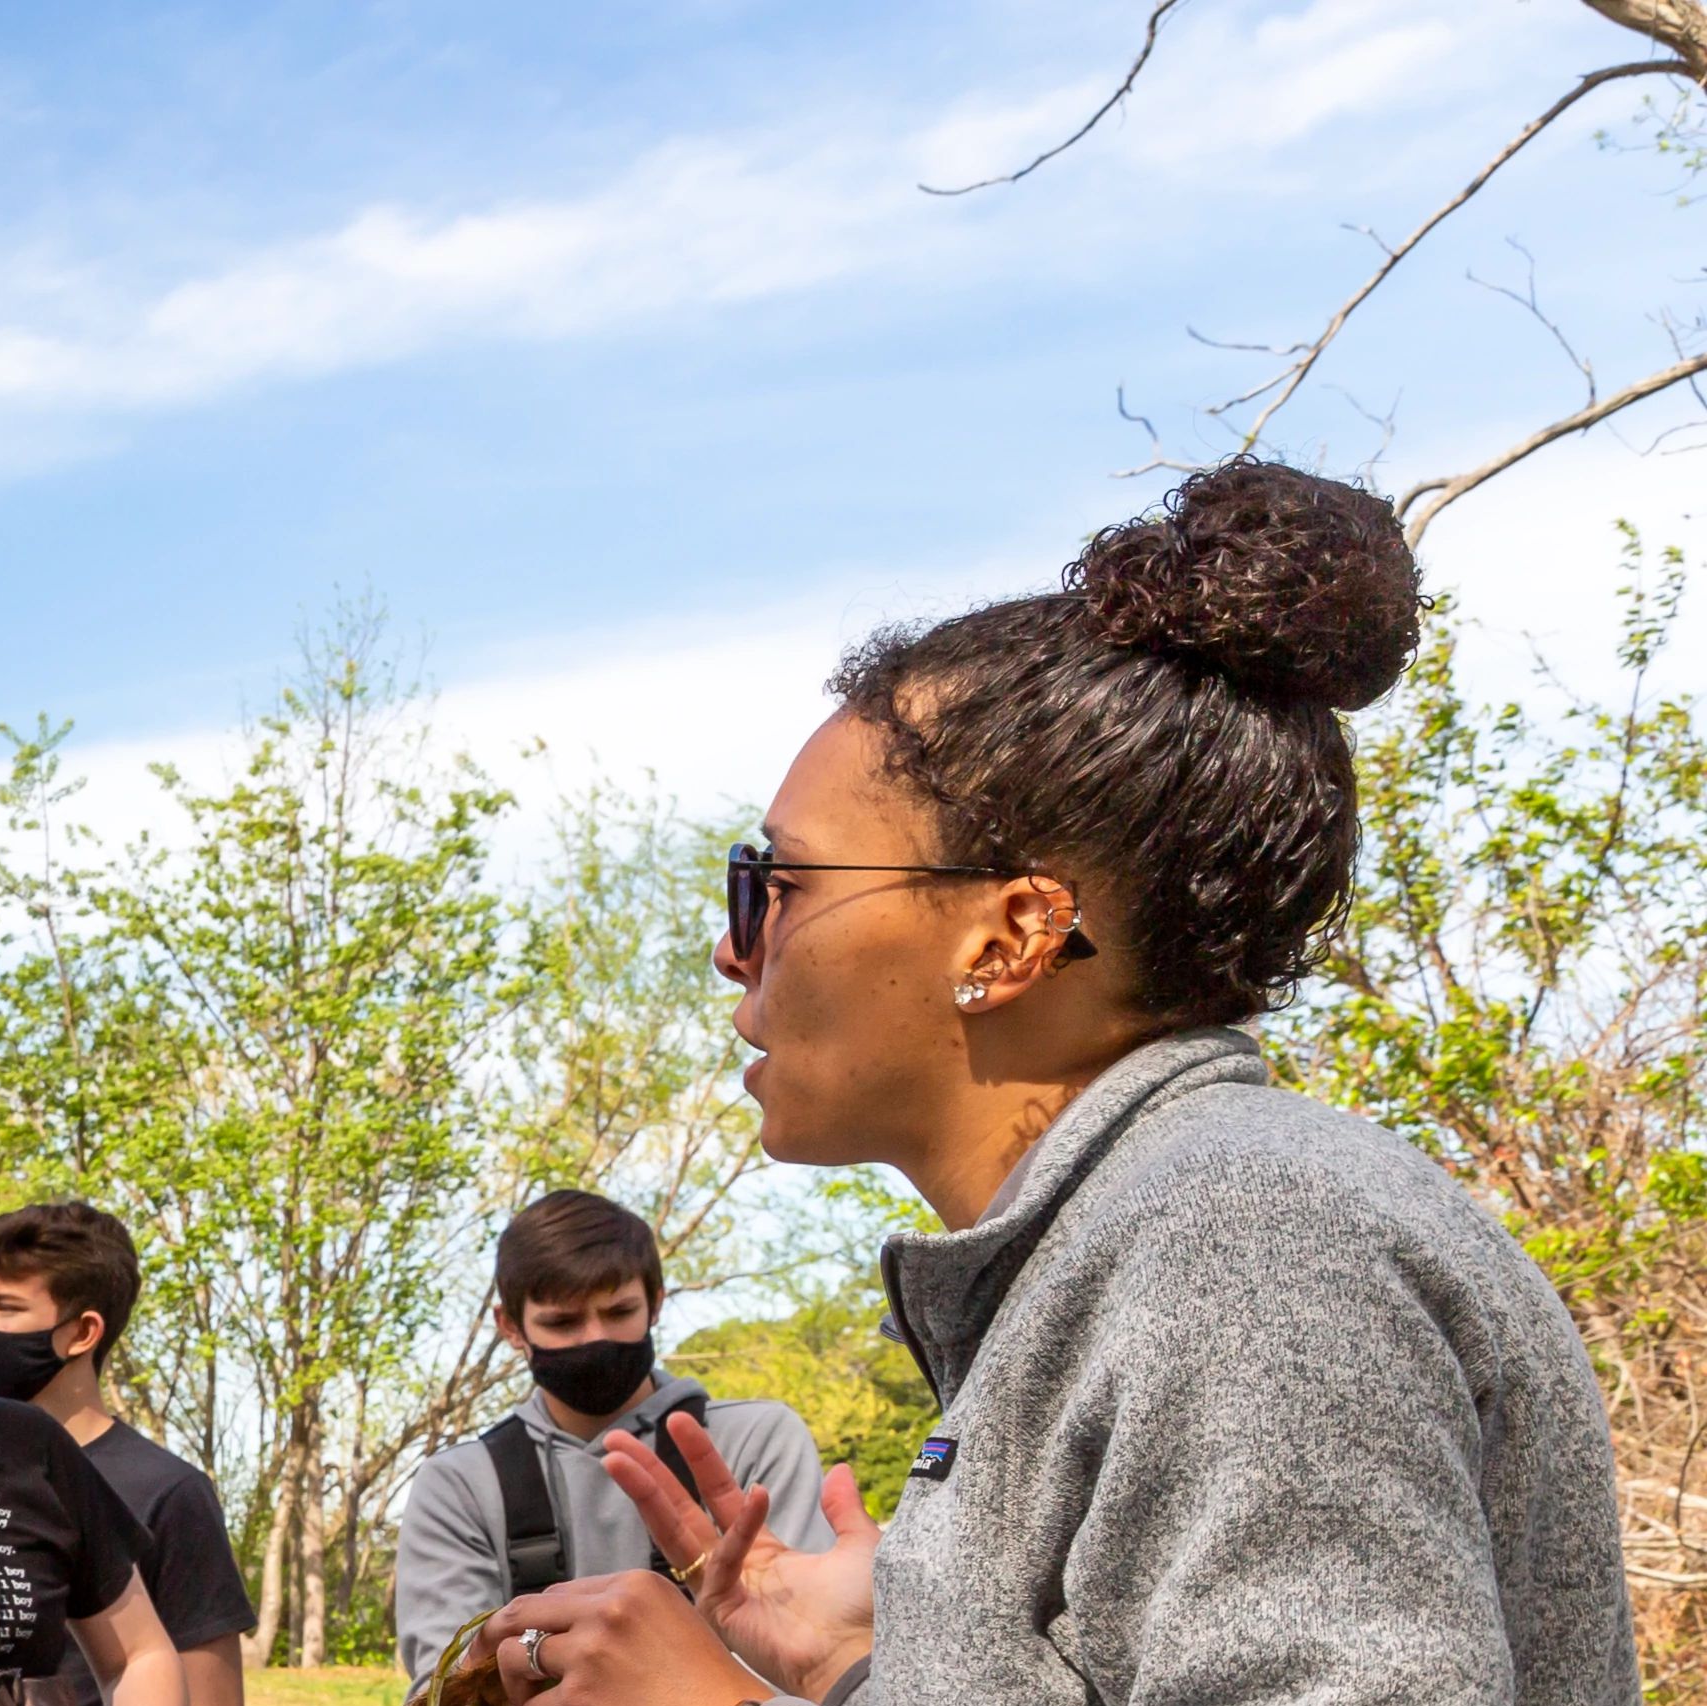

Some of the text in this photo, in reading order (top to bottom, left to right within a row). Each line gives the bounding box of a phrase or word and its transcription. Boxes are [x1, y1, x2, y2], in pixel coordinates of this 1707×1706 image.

[4, 1566, 25, 1578] boy
[11, 1580, 31, 1592] boy
[13, 1594, 33, 1608] boy
[19, 1610, 37, 1622] boy
